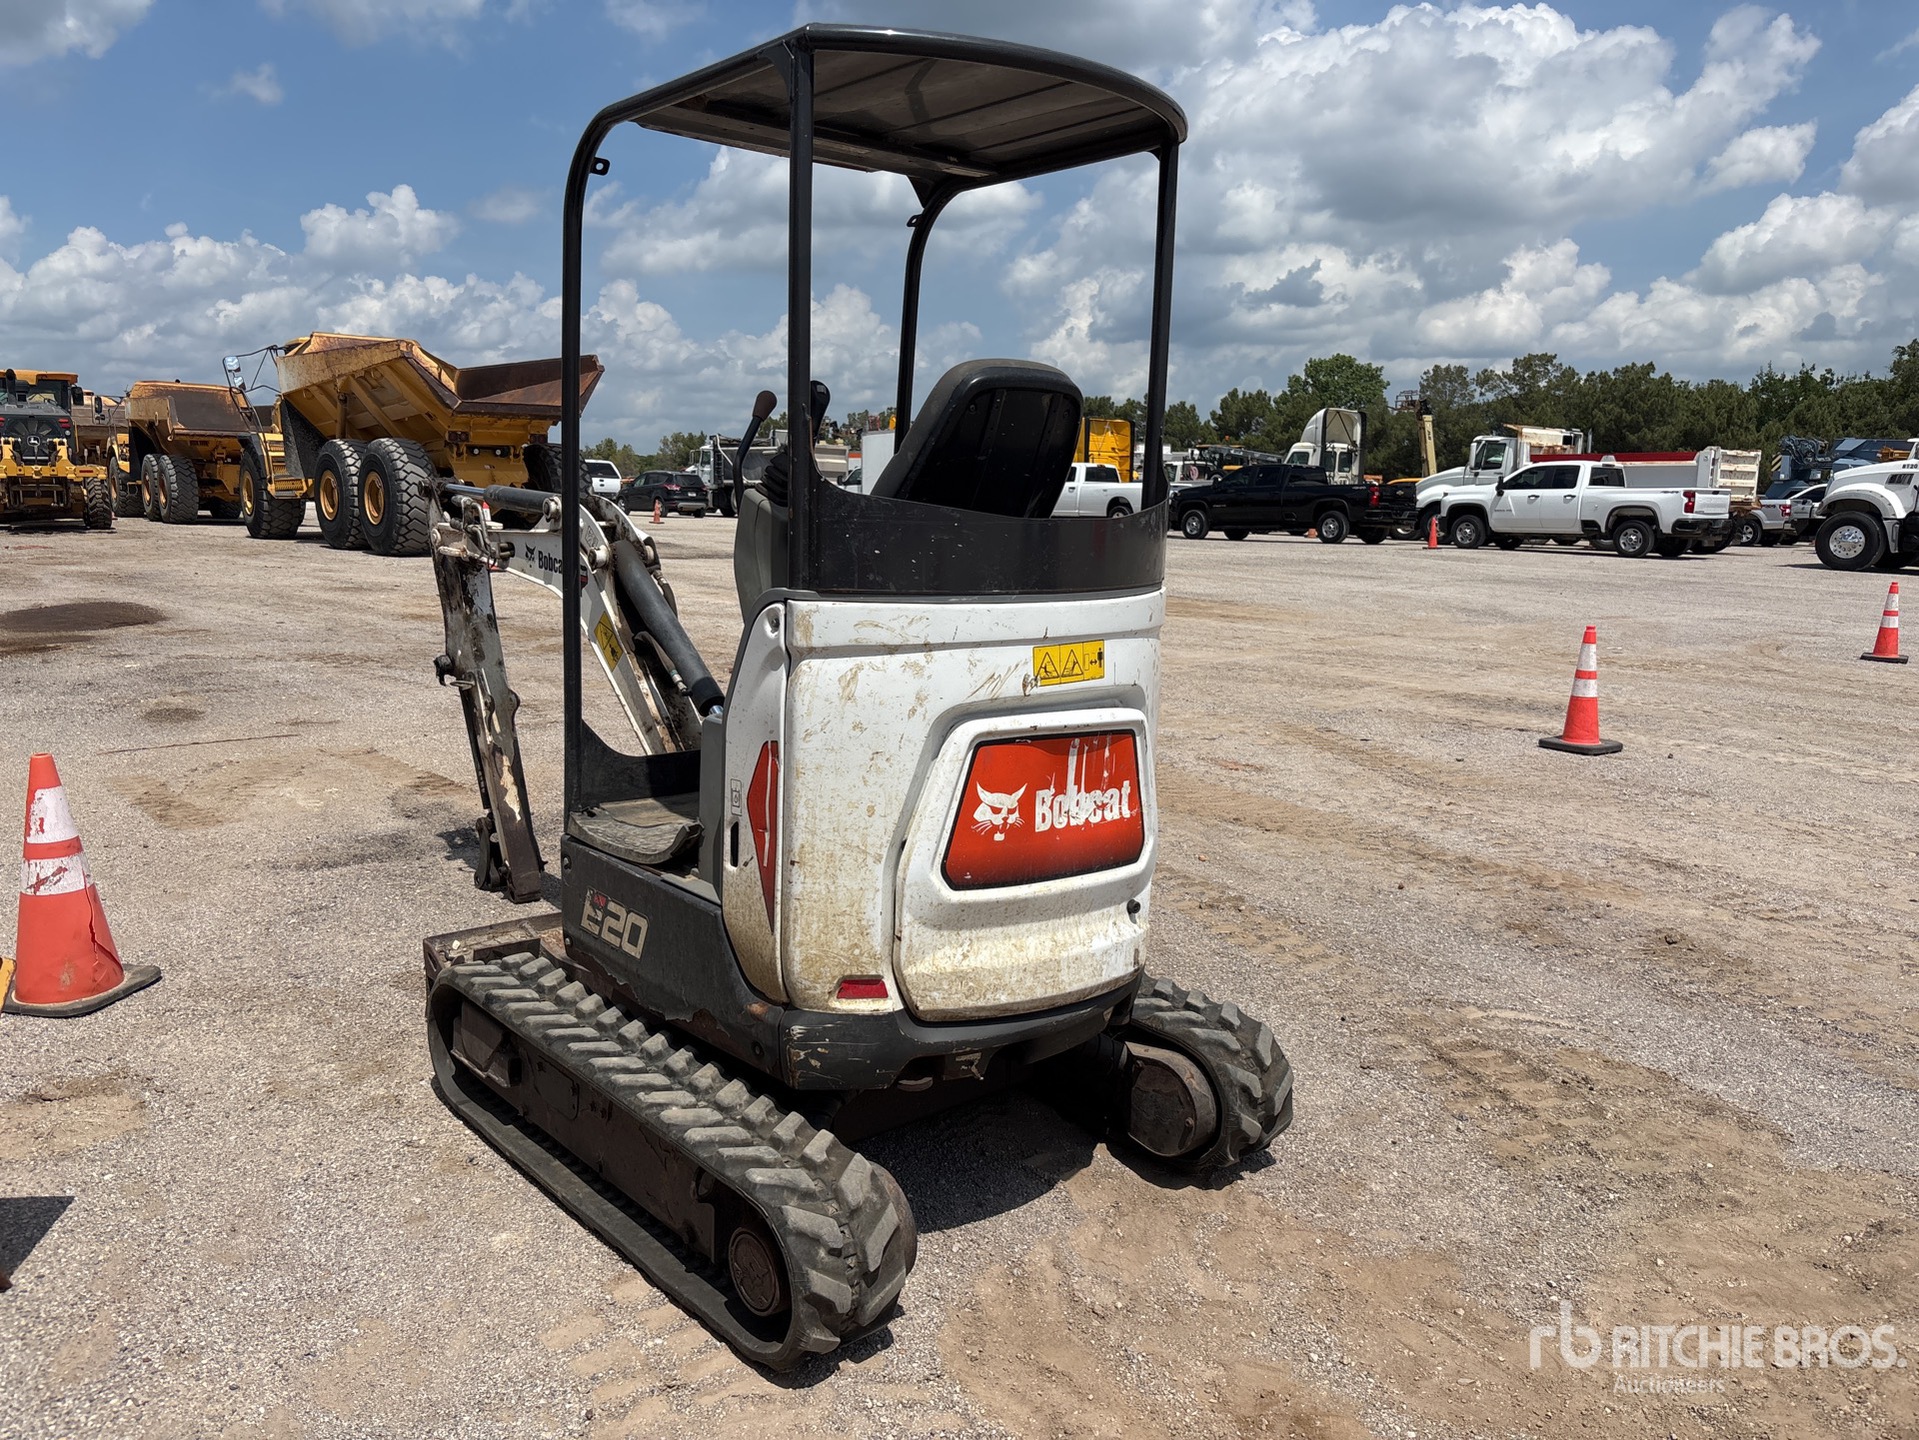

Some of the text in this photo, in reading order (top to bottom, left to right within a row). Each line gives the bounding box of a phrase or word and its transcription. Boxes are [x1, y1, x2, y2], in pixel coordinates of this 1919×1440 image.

[537, 550, 563, 574] Bobca
[1035, 780, 1131, 832] Bobcat
[580, 888, 649, 960] E20
